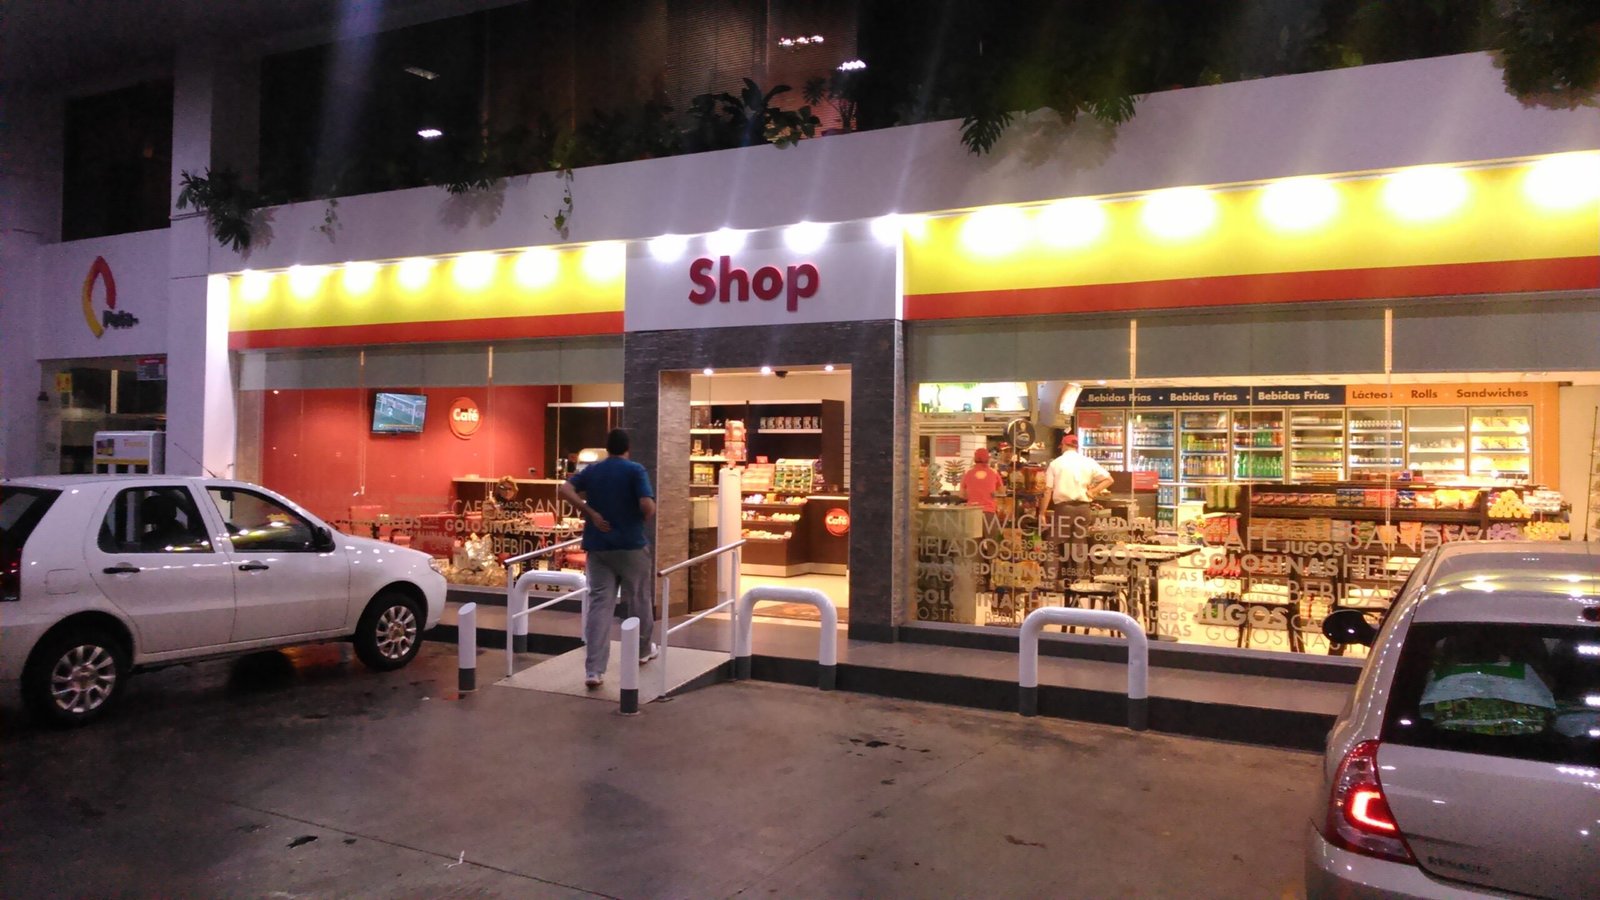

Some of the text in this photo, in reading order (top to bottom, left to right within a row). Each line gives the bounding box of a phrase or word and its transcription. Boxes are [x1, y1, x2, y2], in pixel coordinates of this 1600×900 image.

[689, 255, 820, 312] Shop
[1087, 393, 1125, 403] Bebidas
[1170, 391, 1238, 402] Bebidas Frías
[1258, 390, 1330, 401] Bebidas Frías
[1352, 389, 1393, 400] Lácteos
[1410, 389, 1438, 399] Rolls
[1456, 388, 1529, 398] Sandwiches
[452, 407, 480, 422] Café
[445, 518, 523, 535] GOLOSINAS
[1203, 522, 1277, 553] CAFÉ
[914, 536, 1012, 560] HELADOS
[1014, 551, 1055, 562] JUGOS
[1059, 542, 1147, 566] JUGOS
[1282, 540, 1345, 557] JUGOS
[1190, 552, 1340, 578] GOLOSINAS
[1288, 580, 1402, 609] BEBIDAS
[1194, 601, 1289, 629] JUGOS
